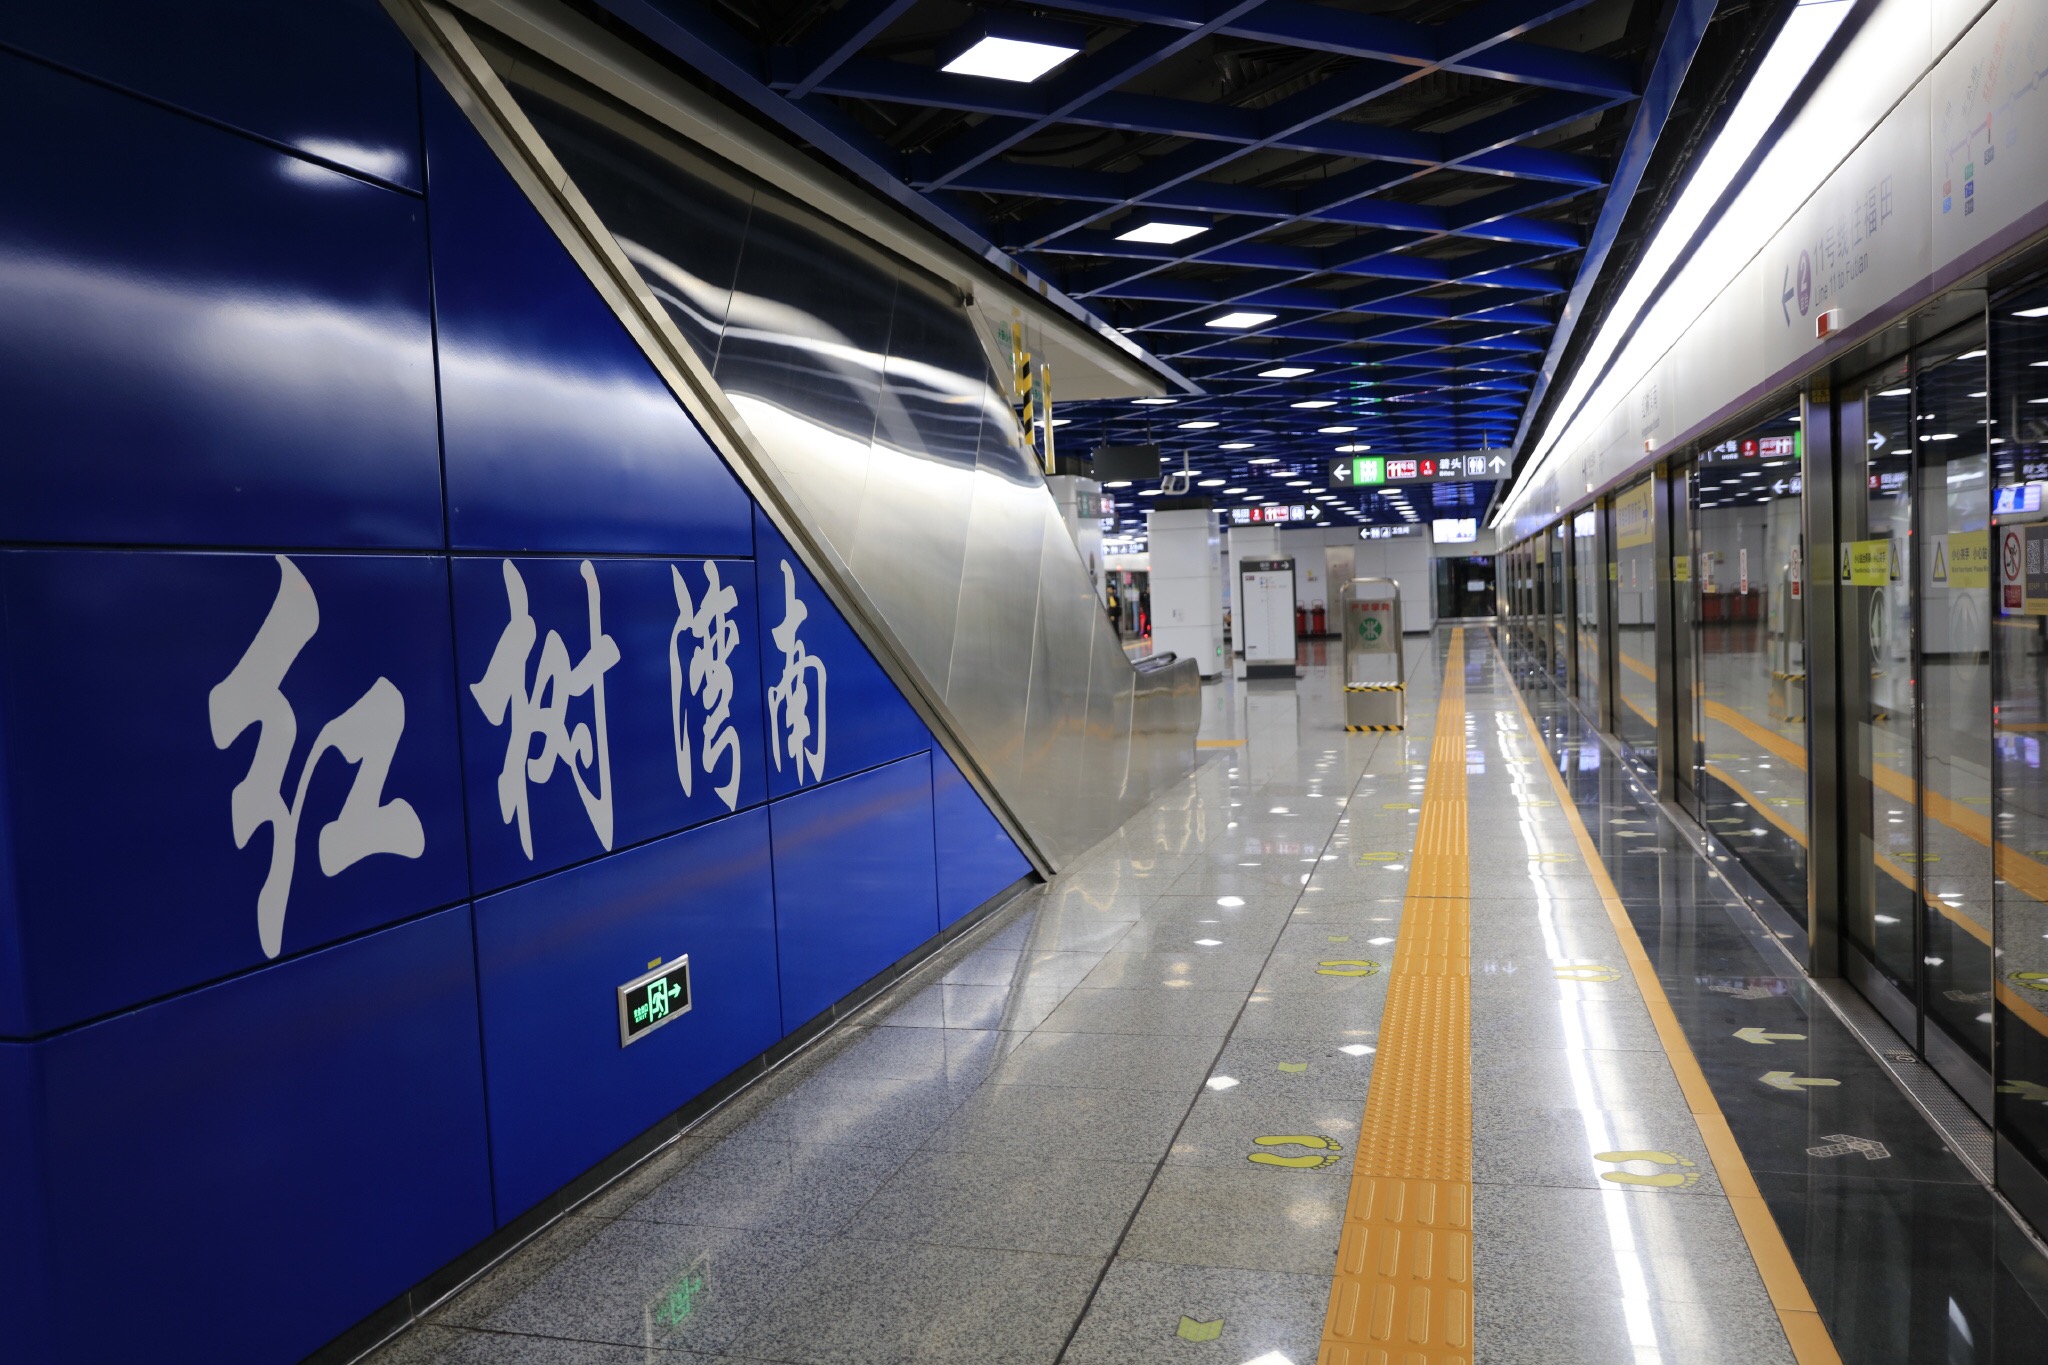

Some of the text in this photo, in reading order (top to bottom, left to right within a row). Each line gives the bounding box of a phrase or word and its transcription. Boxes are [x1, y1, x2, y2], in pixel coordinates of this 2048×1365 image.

[1800, 252, 1808, 293] 2
[1815, 285, 1828, 307] Line
[1845, 252, 1869, 287] Futian
